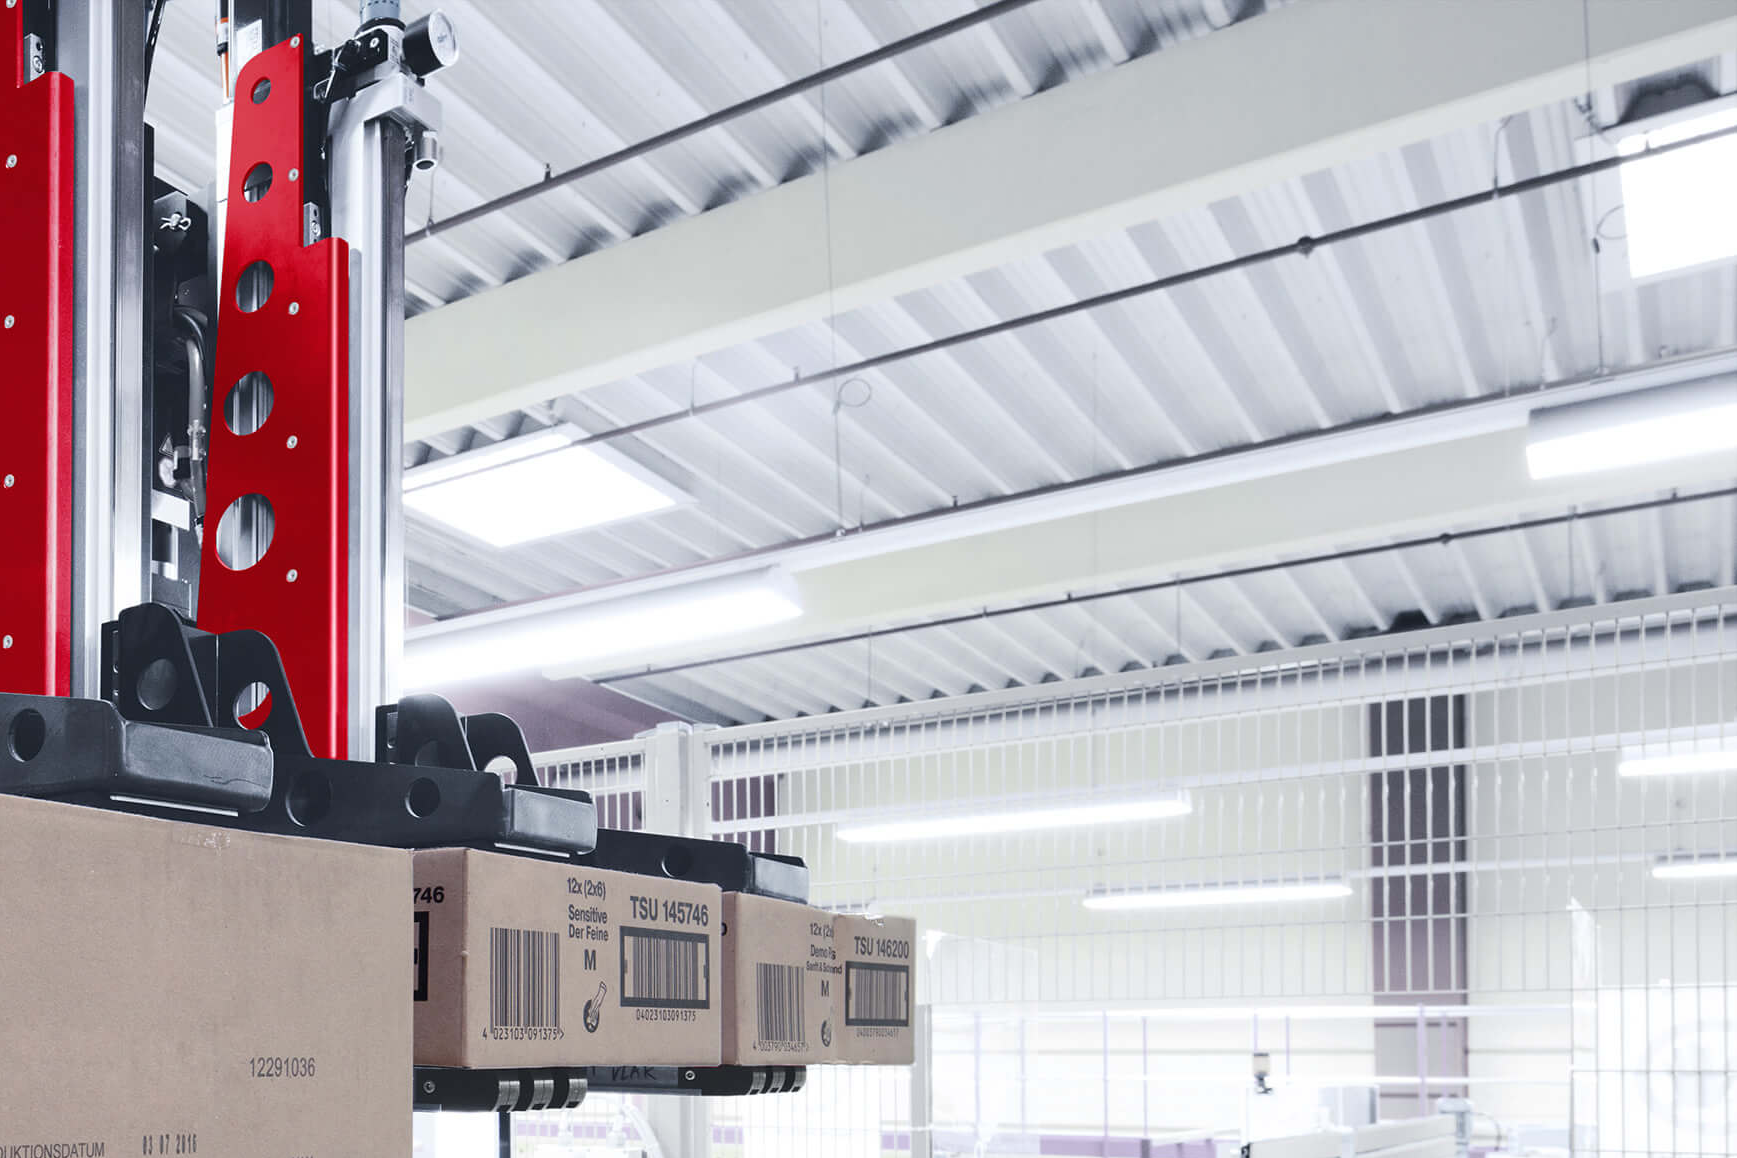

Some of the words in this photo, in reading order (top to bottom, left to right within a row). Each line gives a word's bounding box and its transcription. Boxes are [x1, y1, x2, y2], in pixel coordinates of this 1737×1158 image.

[567, 877, 582, 895] 12x
[584, 880, 606, 901] (2x6)
[568, 903, 608, 924] Sensitive
[630, 896, 659, 921] TSU
[662, 900, 709, 927] 145746
[568, 924, 584, 939] Der
[586, 926, 609, 942] Feine
[810, 923, 822, 938] 12x
[854, 936, 874, 954] TSU
[876, 938, 910, 959] 146200
[584, 949, 597, 971] M
[821, 980, 830, 997] M
[636, 1008, 696, 1022] 04023103091375
[482, 1028, 488, 1040] 4
[493, 1027, 524, 1040] 023103
[528, 1027, 558, 1040] 091375
[250, 1057, 316, 1078] 12291036
[142, 1135, 153, 1156] 03
[159, 1133, 170, 1154] 07
[176, 1133, 197, 1154] 2016
